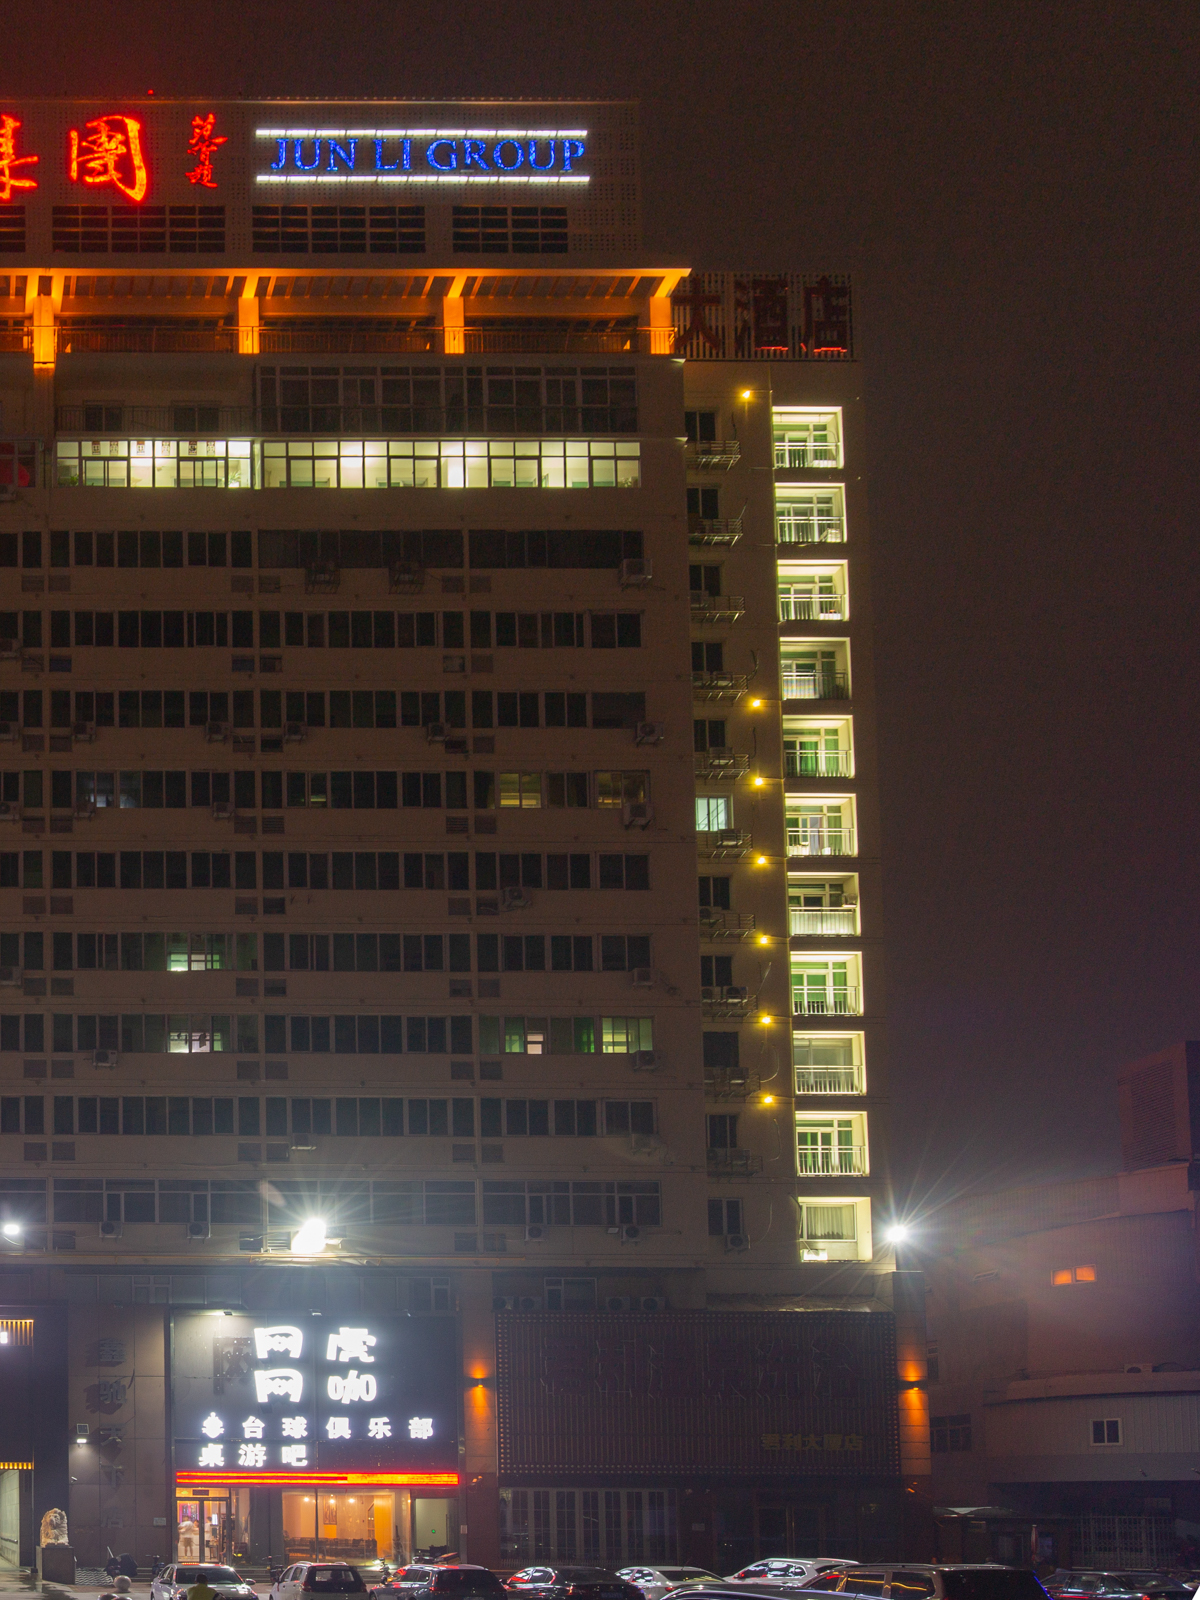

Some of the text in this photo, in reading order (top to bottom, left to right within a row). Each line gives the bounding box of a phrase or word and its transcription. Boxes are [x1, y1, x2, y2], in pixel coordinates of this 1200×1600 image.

[270, 138, 587, 172] JUN LI GROUP
[242, 1416, 434, 1439] 台球俱乐部
[199, 1443, 308, 1467] 桌游吧
